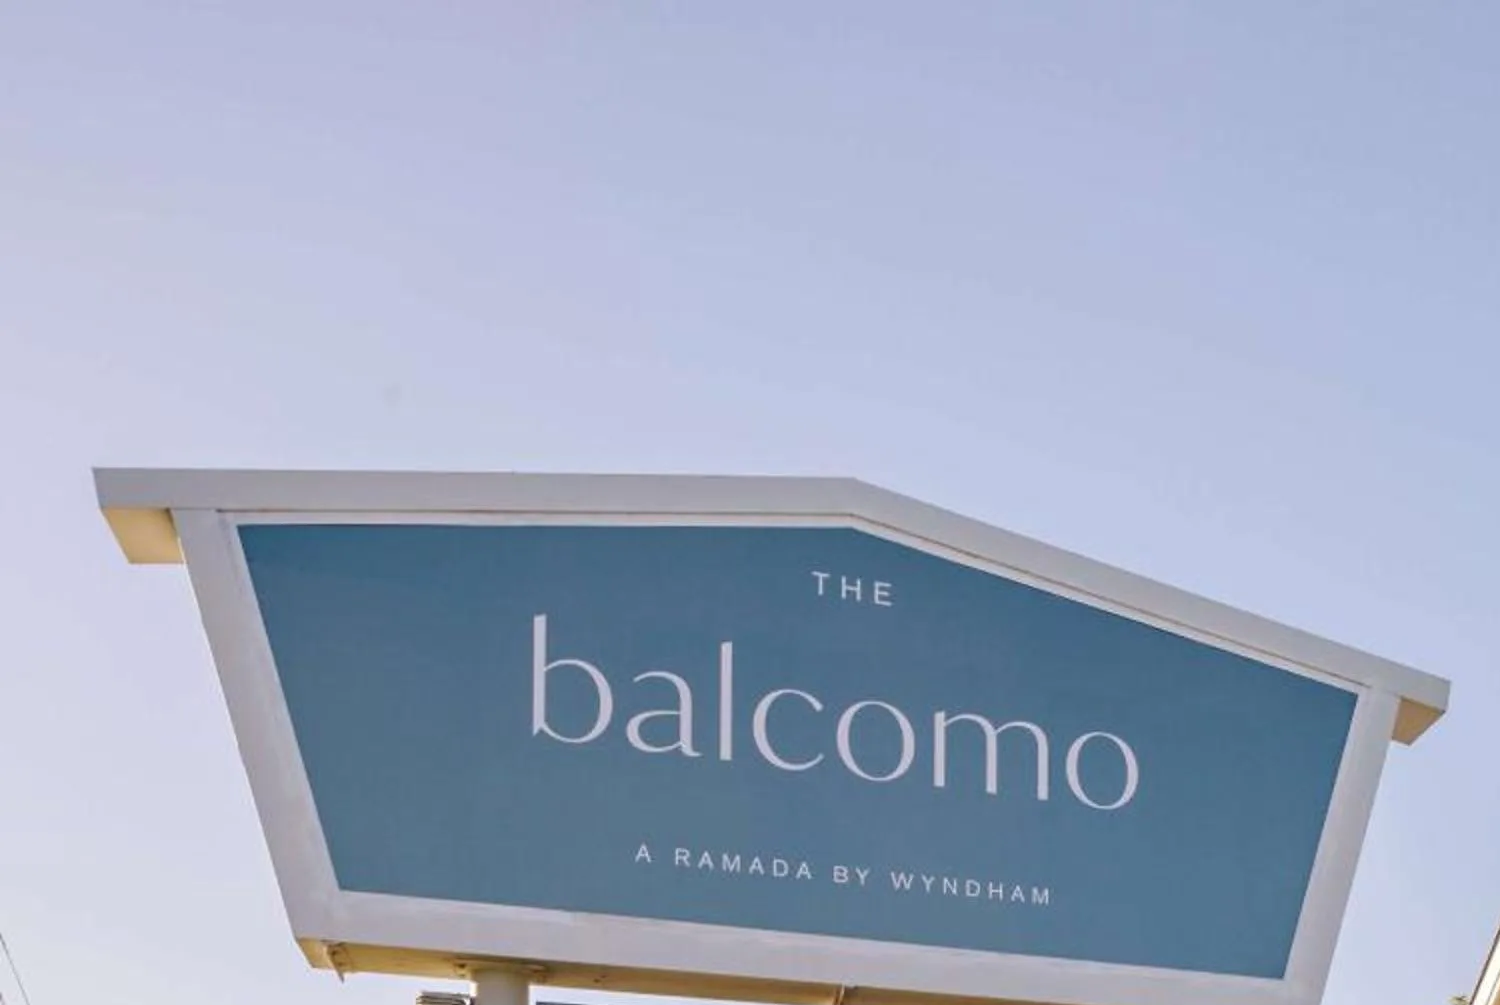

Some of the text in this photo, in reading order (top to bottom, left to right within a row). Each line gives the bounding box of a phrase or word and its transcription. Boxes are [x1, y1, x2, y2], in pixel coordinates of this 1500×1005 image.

[812, 571, 893, 606] THE
[532, 613, 1140, 810] balcomo
[635, 843, 1051, 905] A RAMADA BY WYNDHAM
